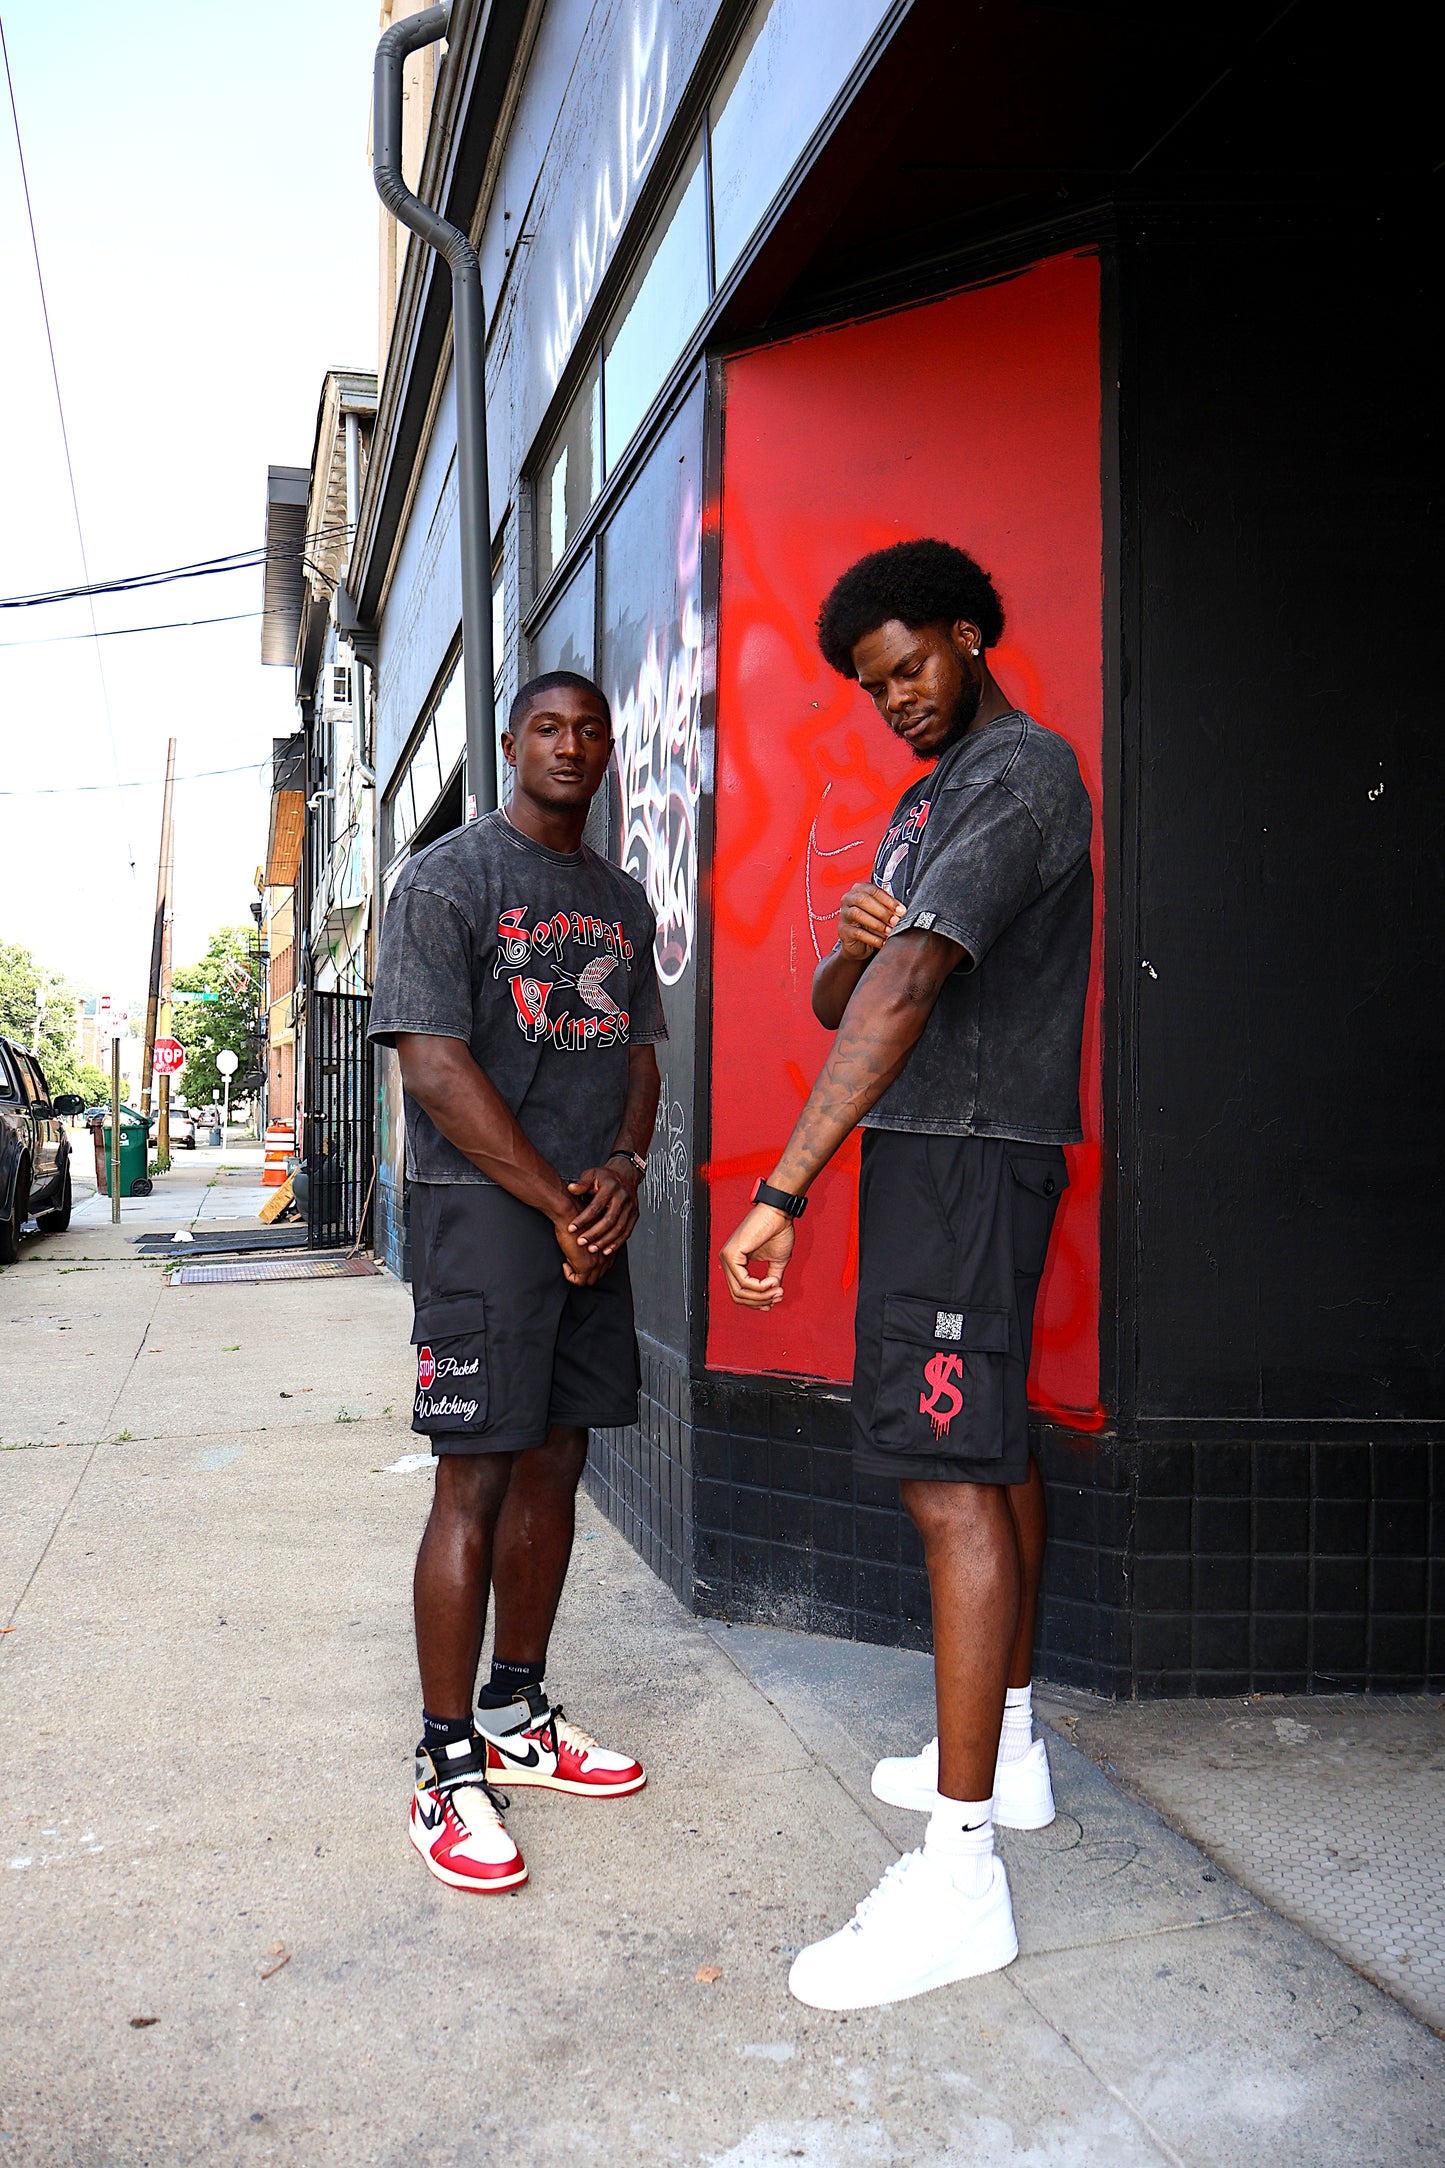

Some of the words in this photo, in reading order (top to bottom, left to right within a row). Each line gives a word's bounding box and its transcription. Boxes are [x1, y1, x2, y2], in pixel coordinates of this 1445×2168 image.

[508, 974, 630, 1051] Purse
[419, 1360, 434, 1377] STOP
[414, 1391, 479, 1422] Watching
